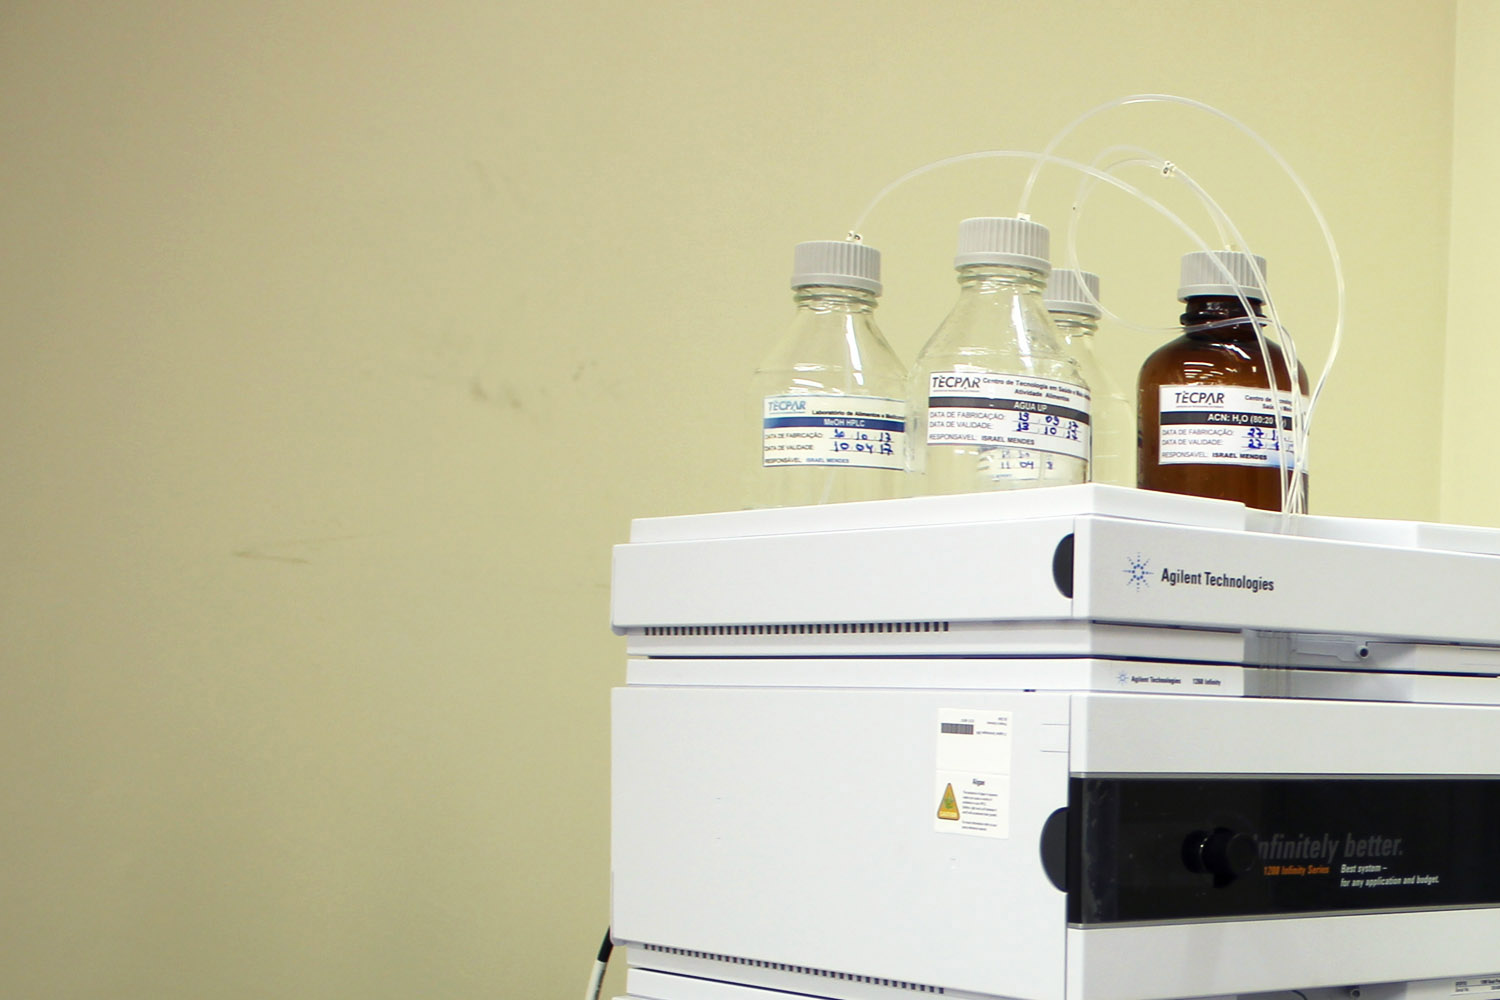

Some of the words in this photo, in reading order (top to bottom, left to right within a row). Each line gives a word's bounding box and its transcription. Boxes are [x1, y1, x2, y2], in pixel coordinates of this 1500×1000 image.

[932, 376, 981, 390] TECPAR
[1175, 390, 1225, 405] TECPAR
[768, 400, 806, 412] TECPAR
[1207, 413, 1230, 422] ACN:
[1007, 437, 1035, 445] MENDES
[1161, 568, 1202, 586] Agilent
[1204, 571, 1275, 593] Technologies
[1343, 831, 1404, 859] better.
[1340, 863, 1357, 873] Best
[1357, 865, 1382, 874] system
[1340, 877, 1351, 887] for
[1351, 879, 1364, 888] any
[1365, 876, 1402, 888] application
[1403, 875, 1416, 884] and
